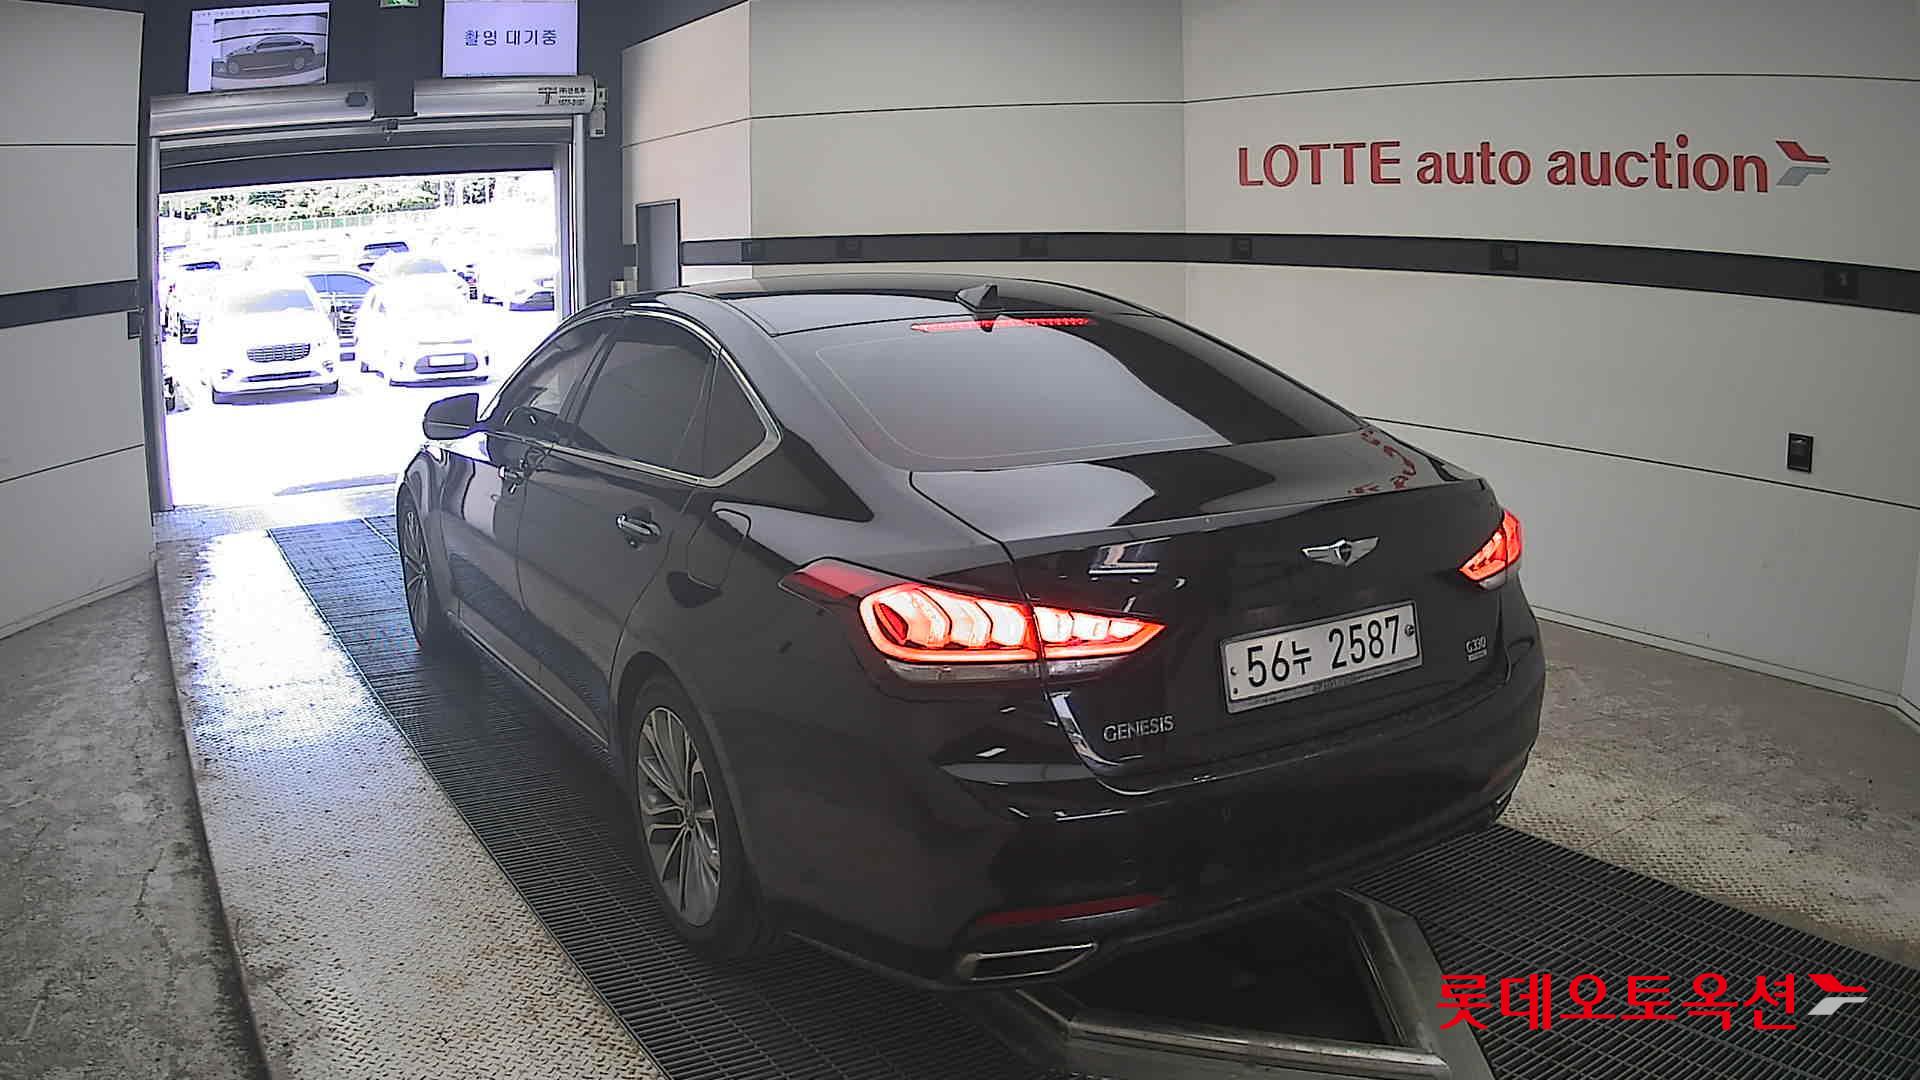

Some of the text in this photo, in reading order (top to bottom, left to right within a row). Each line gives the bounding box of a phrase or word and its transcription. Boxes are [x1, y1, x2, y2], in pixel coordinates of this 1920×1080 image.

[505, 29, 558, 46] 대기중
[1238, 134, 1769, 193] LOTTE auto auction
[1246, 614, 1400, 688] 56누 2587
[1103, 715, 1175, 742] GENESIS
